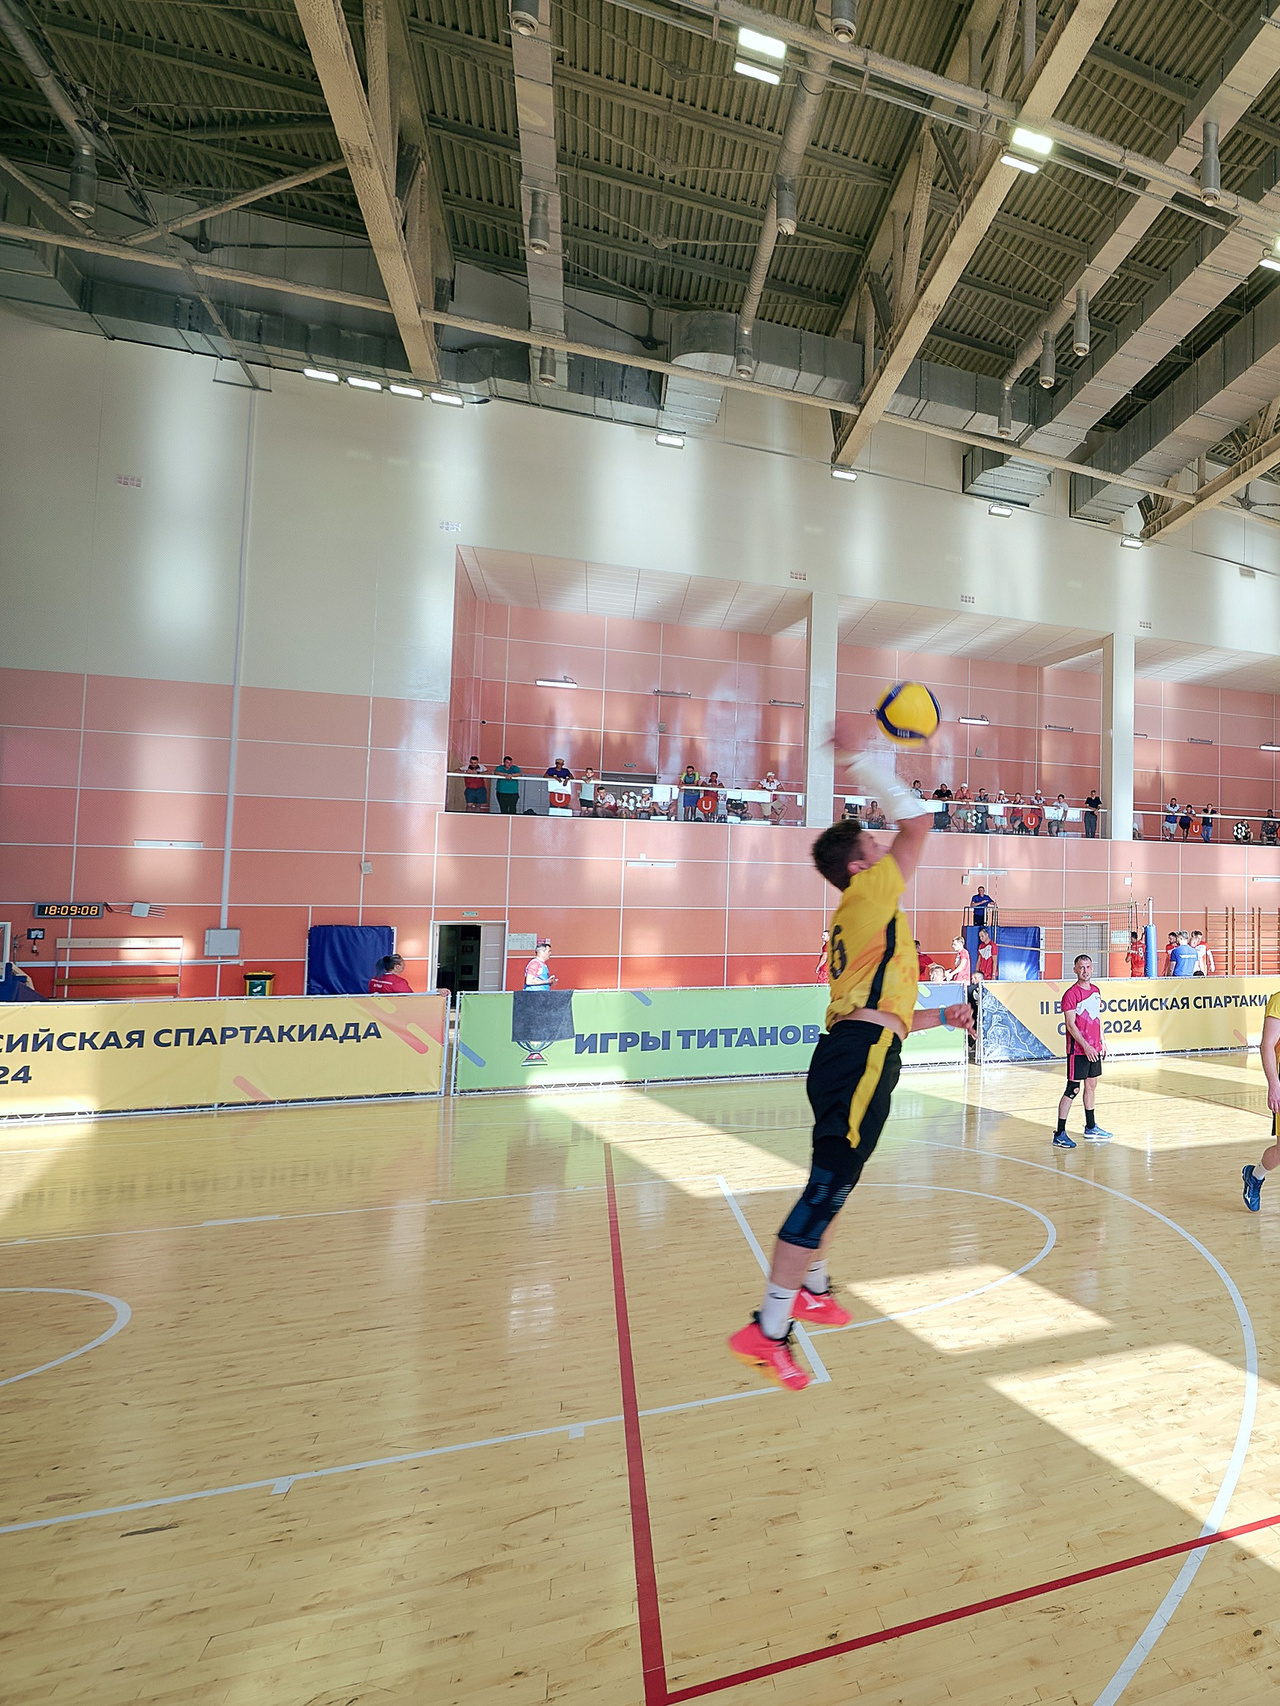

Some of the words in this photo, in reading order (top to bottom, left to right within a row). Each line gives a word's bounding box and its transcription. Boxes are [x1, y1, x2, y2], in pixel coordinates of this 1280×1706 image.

[44, 905, 98, 916] 18:09:08
[153, 1022, 382, 1048] СПАРТАКИАДА
[1103, 1020, 1142, 1034] 2024
[574, 1030, 670, 1055] ИГРЫ
[676, 1024, 821, 1050] ТИТАНОВ
